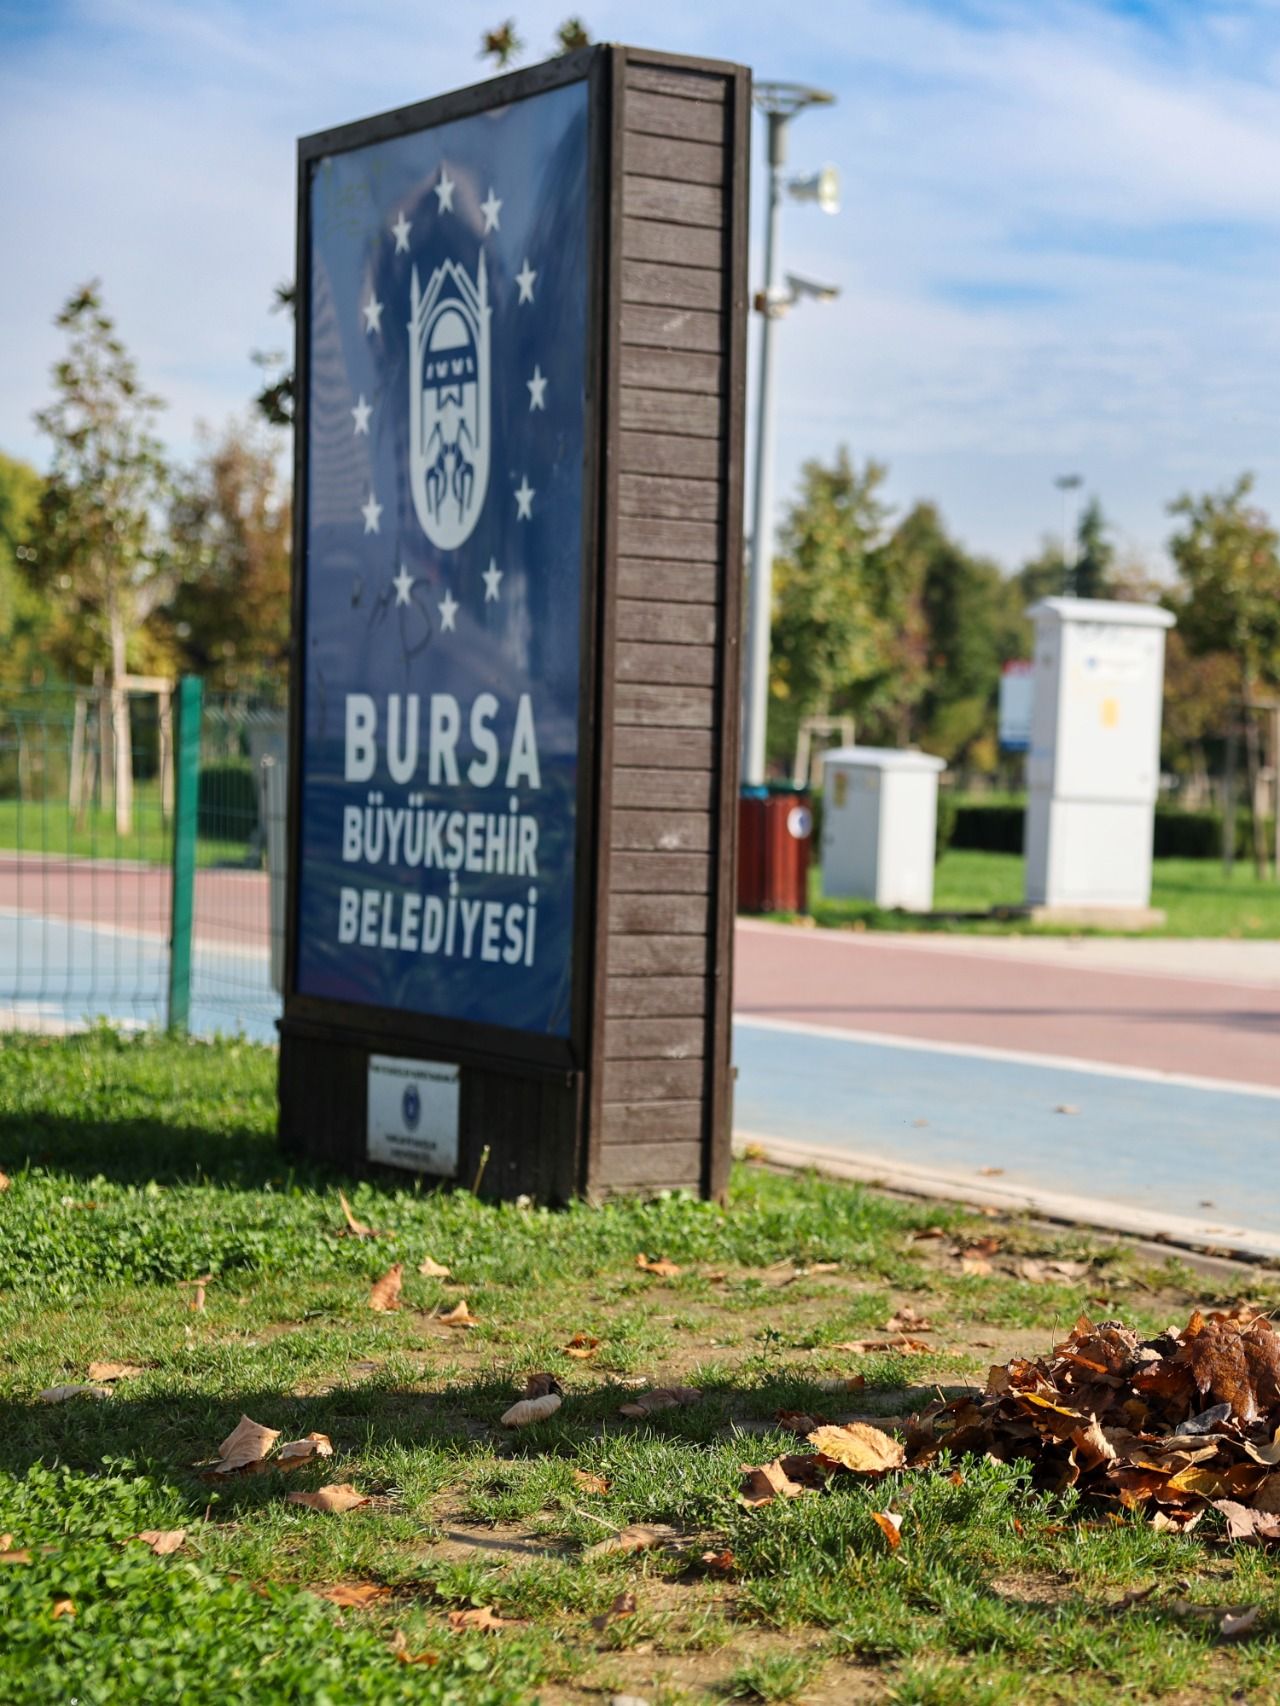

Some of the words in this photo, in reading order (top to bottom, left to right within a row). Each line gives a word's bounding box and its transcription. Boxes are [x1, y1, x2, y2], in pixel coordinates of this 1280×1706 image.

[345, 693, 541, 789] BURSA
[342, 791, 538, 880] BÜYÜKŞEHİR
[338, 881, 536, 967] BELEDİYESİ
